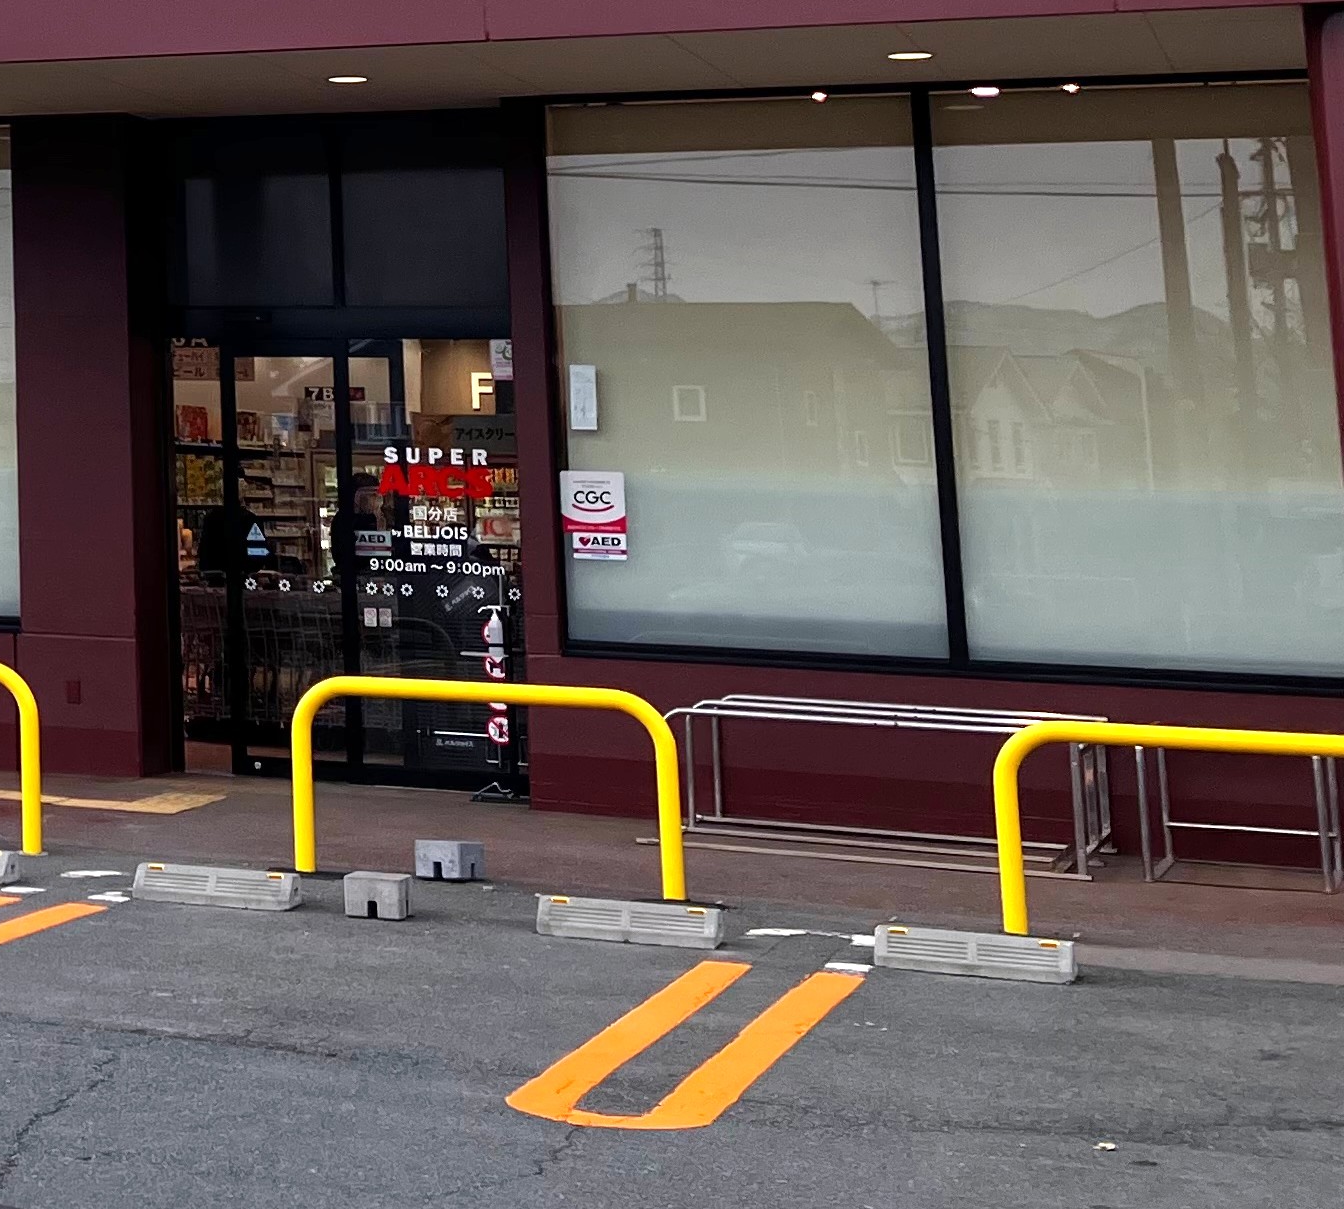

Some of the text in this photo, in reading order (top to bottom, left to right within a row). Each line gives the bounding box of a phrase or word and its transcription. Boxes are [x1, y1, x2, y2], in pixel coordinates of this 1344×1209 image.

[308, 387, 335, 401] 7B
[383, 446, 488, 466] SUPER
[378, 463, 494, 498] ARCS
[573, 490, 612, 505] CGC
[412, 506, 458, 523] 国分店
[358, 533, 386, 544] AED
[391, 524, 468, 540] by BELJOIS
[590, 536, 622, 547] AED
[410, 543, 462, 558] 営業時間
[369, 558, 427, 573] 9:00am
[446, 560, 506, 578] 9:00pm
